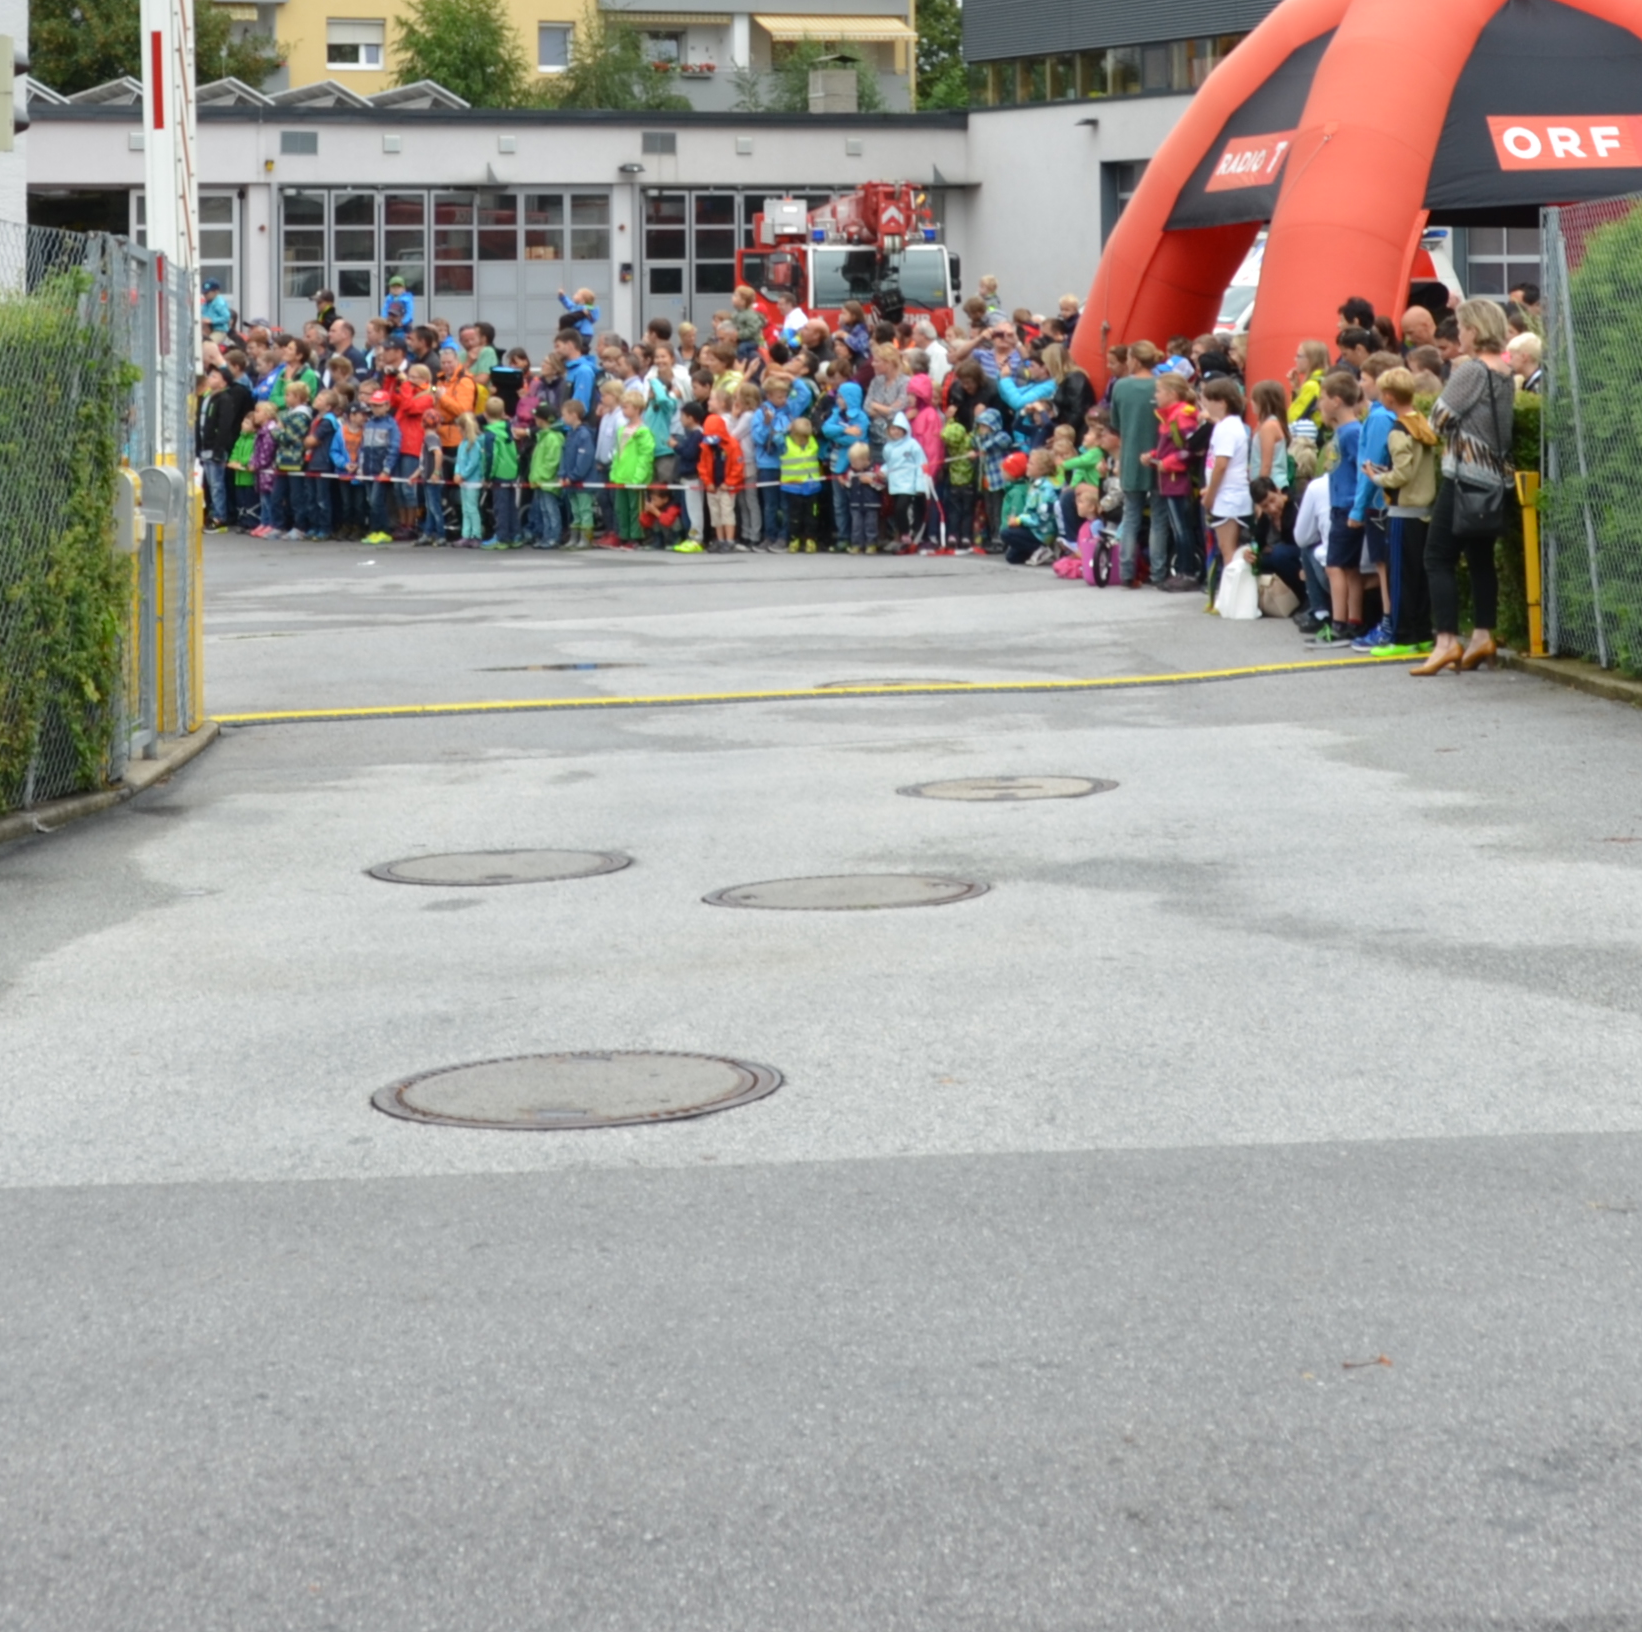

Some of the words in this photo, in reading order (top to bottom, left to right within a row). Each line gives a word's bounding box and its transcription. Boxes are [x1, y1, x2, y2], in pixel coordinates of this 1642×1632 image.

[1215, 149, 1267, 176] RADIO
[1266, 140, 1289, 174] T
[1502, 125, 1621, 160] ORF
